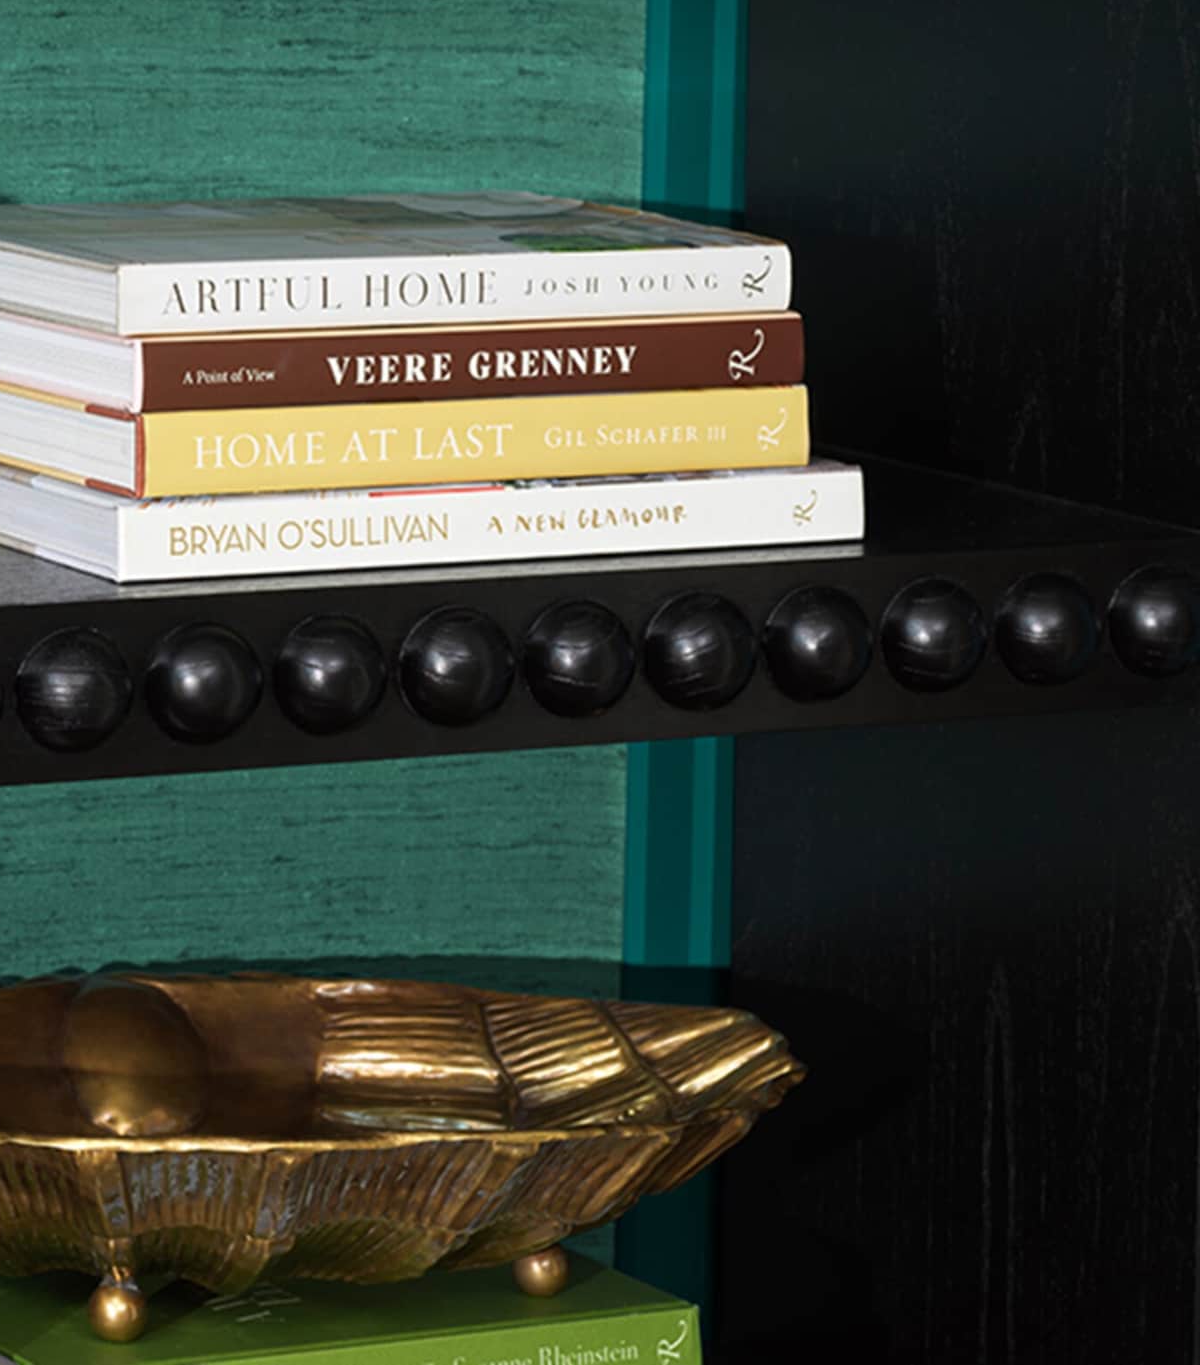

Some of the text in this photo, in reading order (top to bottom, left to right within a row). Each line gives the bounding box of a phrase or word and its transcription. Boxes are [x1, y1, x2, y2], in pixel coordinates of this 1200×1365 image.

[162, 254, 773, 315] ARTFUL HOME JOSH YOUNG R
[182, 328, 766, 386] A Point of View VEERE GRENNEY R
[193, 431, 326, 470] HOME
[340, 427, 398, 464] AT
[413, 423, 514, 461] LAST
[756, 407, 789, 452] R
[168, 523, 267, 558] BRYAN
[277, 511, 451, 551] O'SULLIVAN
[486, 515, 504, 536] A
[514, 510, 567, 534] NEW
[577, 504, 688, 530] GLAMOUR
[538, 1339, 639, 1365] Rheinstein
